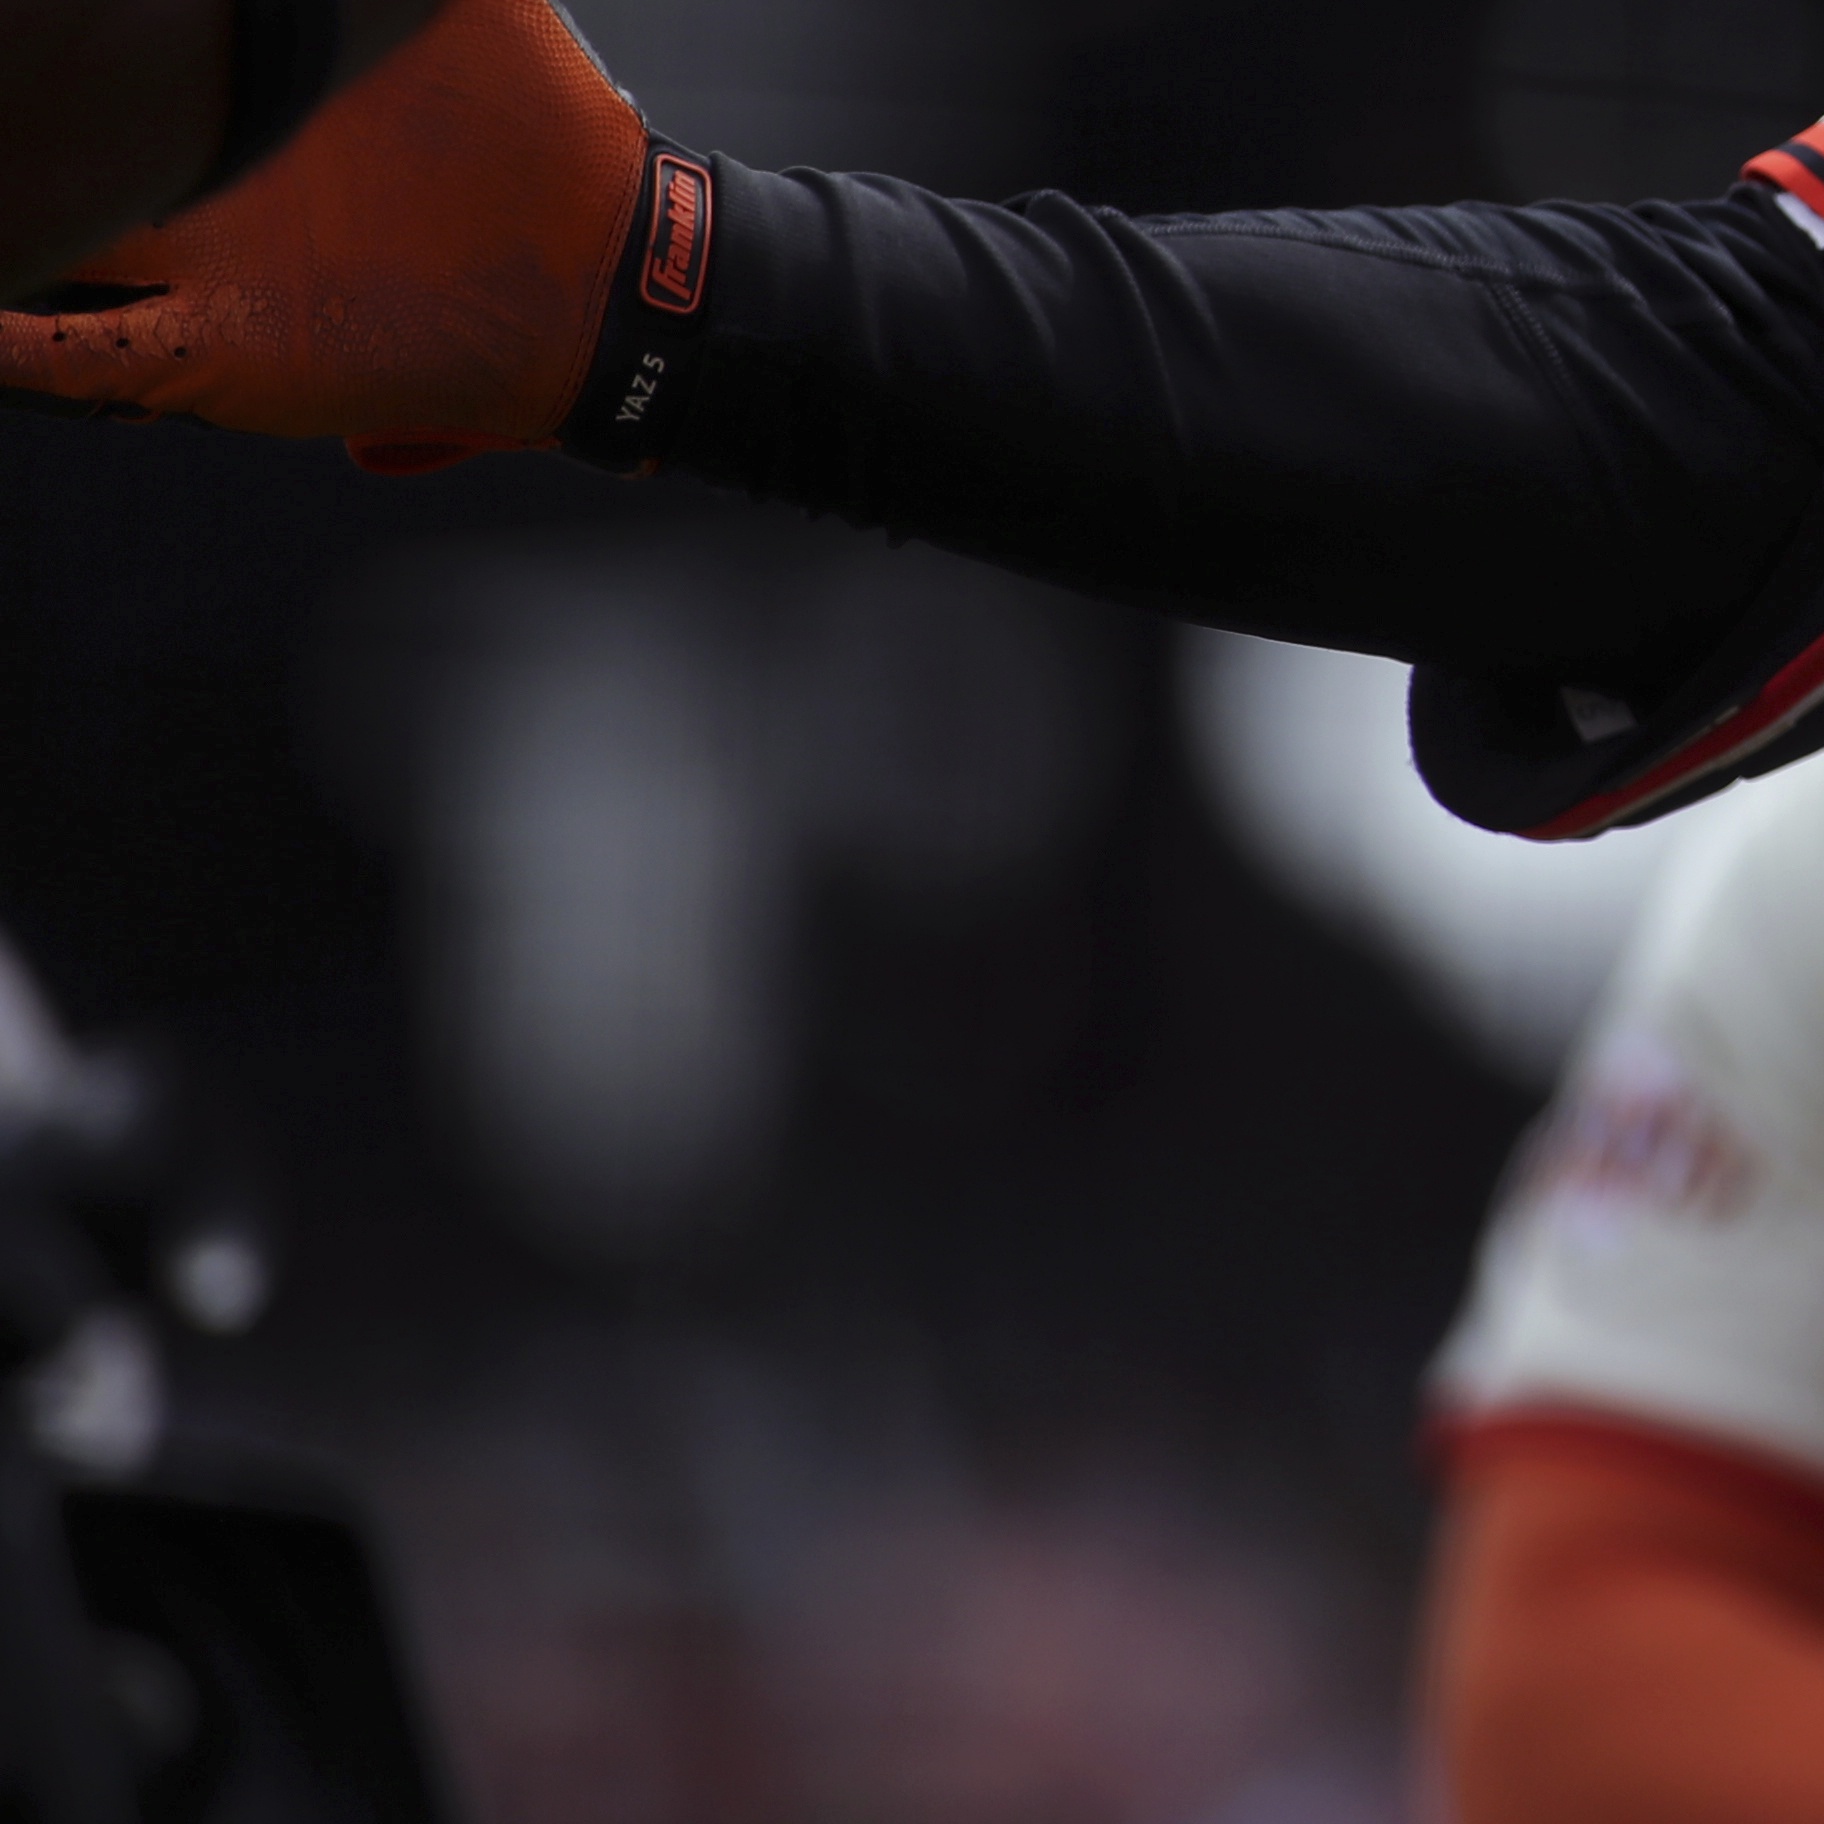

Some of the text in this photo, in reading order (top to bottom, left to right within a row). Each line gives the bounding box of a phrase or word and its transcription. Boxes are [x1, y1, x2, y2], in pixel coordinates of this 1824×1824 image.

[652, 169, 698, 301] Franklin
[615, 352, 666, 424] YAZ 5
